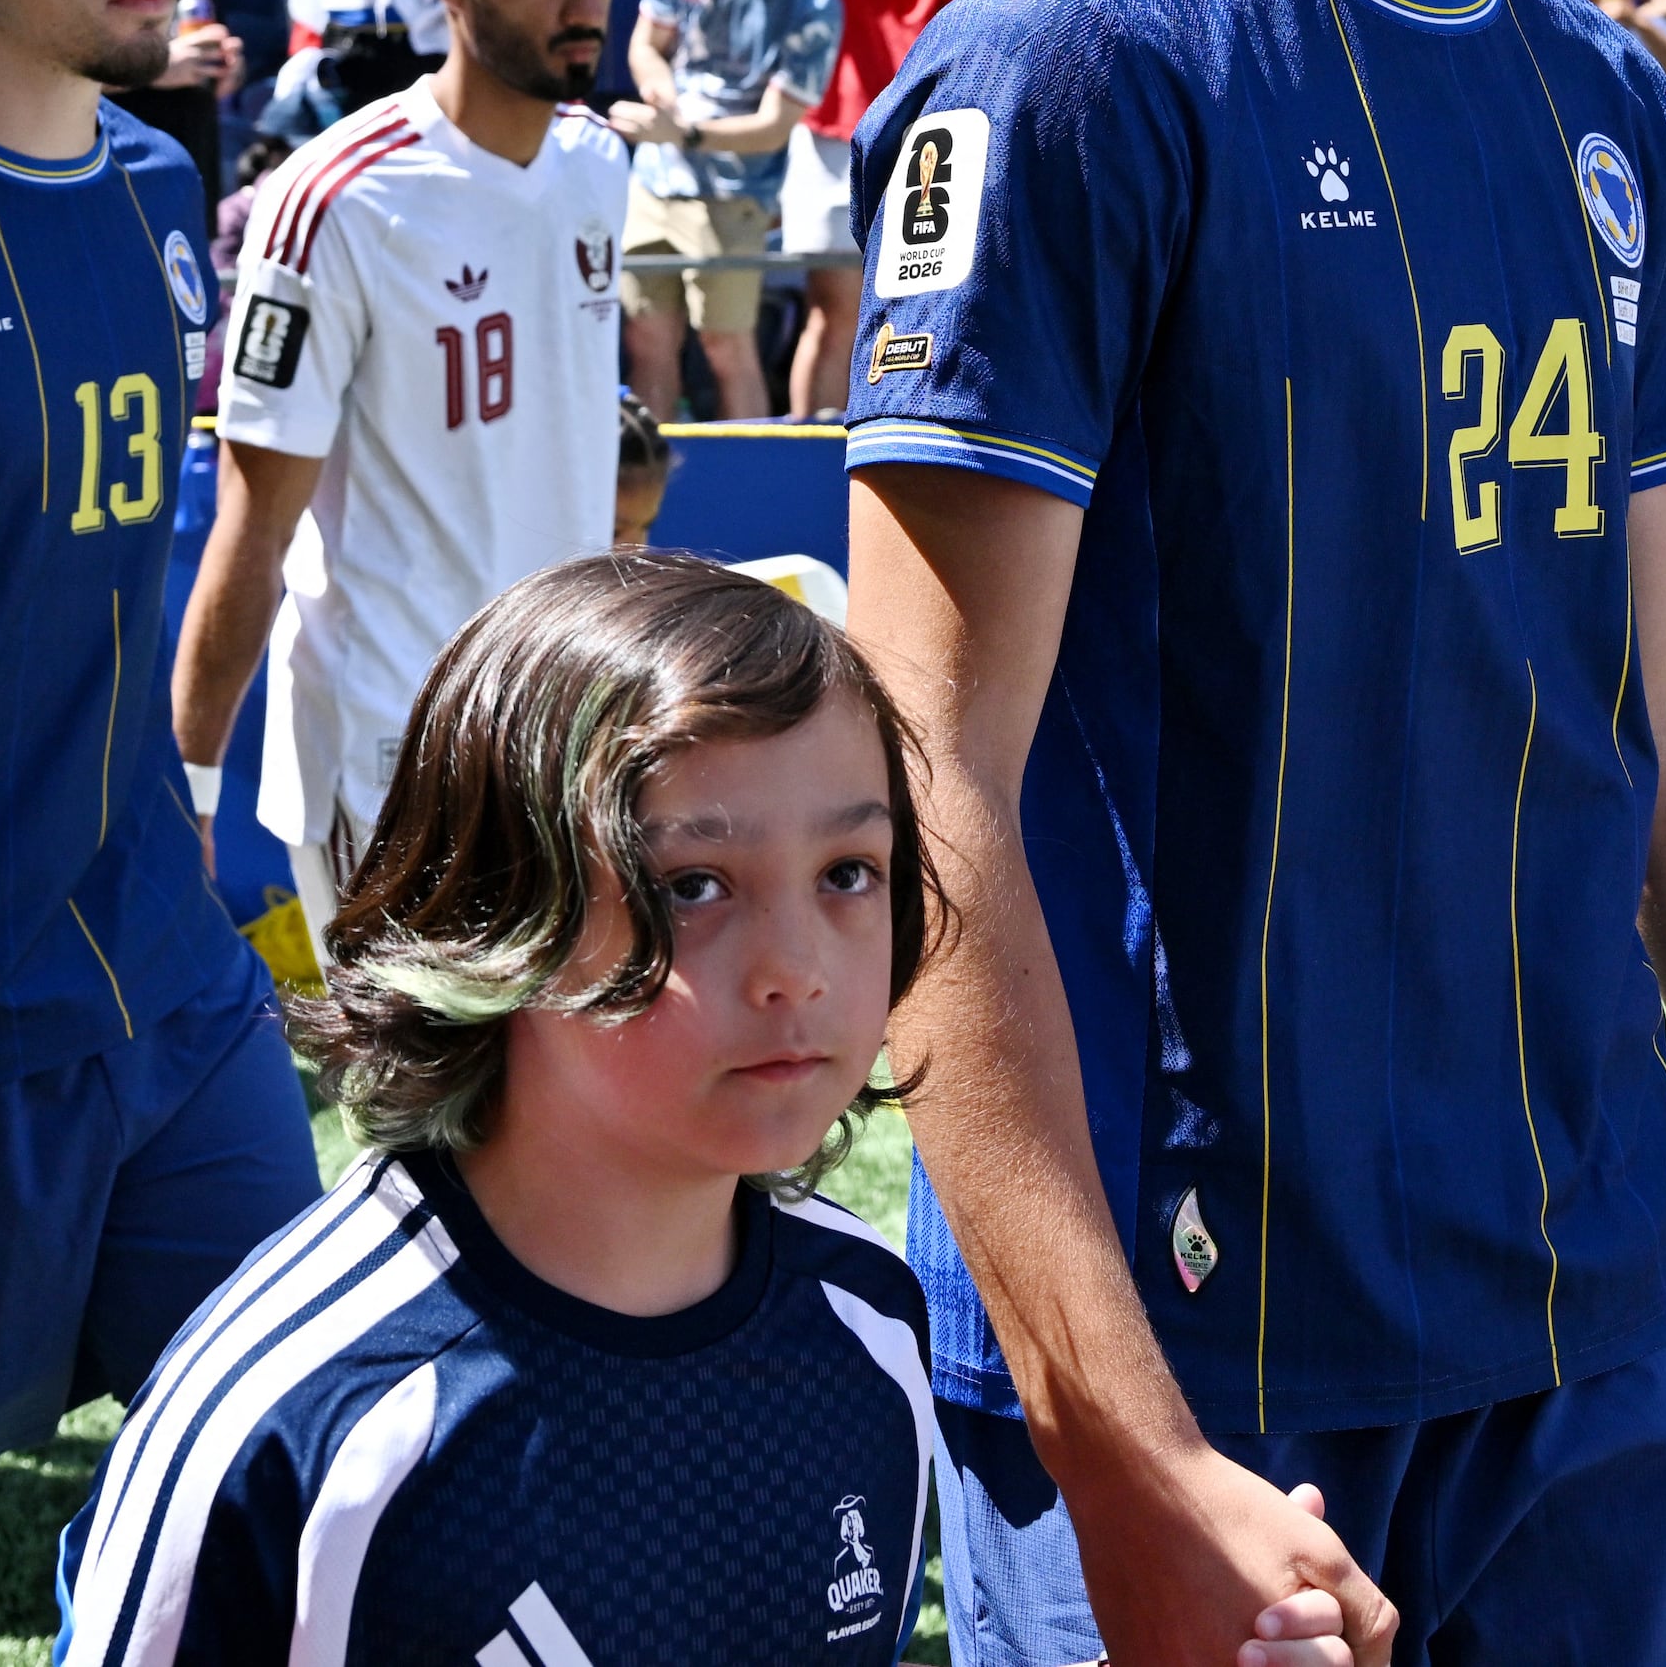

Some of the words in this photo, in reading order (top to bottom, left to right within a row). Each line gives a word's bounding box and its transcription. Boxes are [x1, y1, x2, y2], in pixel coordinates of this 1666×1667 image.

[912, 220, 937, 235] FIFA
[1301, 210, 1377, 229] KELME
[900, 250, 929, 262] WORLD
[930, 247, 946, 259] CUP
[898, 261, 944, 281] 2026
[886, 340, 926, 355] DEBUT
[436, 312, 513, 432] 18
[1442, 318, 1606, 556] 24
[71, 372, 164, 535] 13
[1180, 1252, 1212, 1261] KELME
[827, 1567, 882, 1613] QUAKER
[827, 1622, 862, 1643] PLAYER
